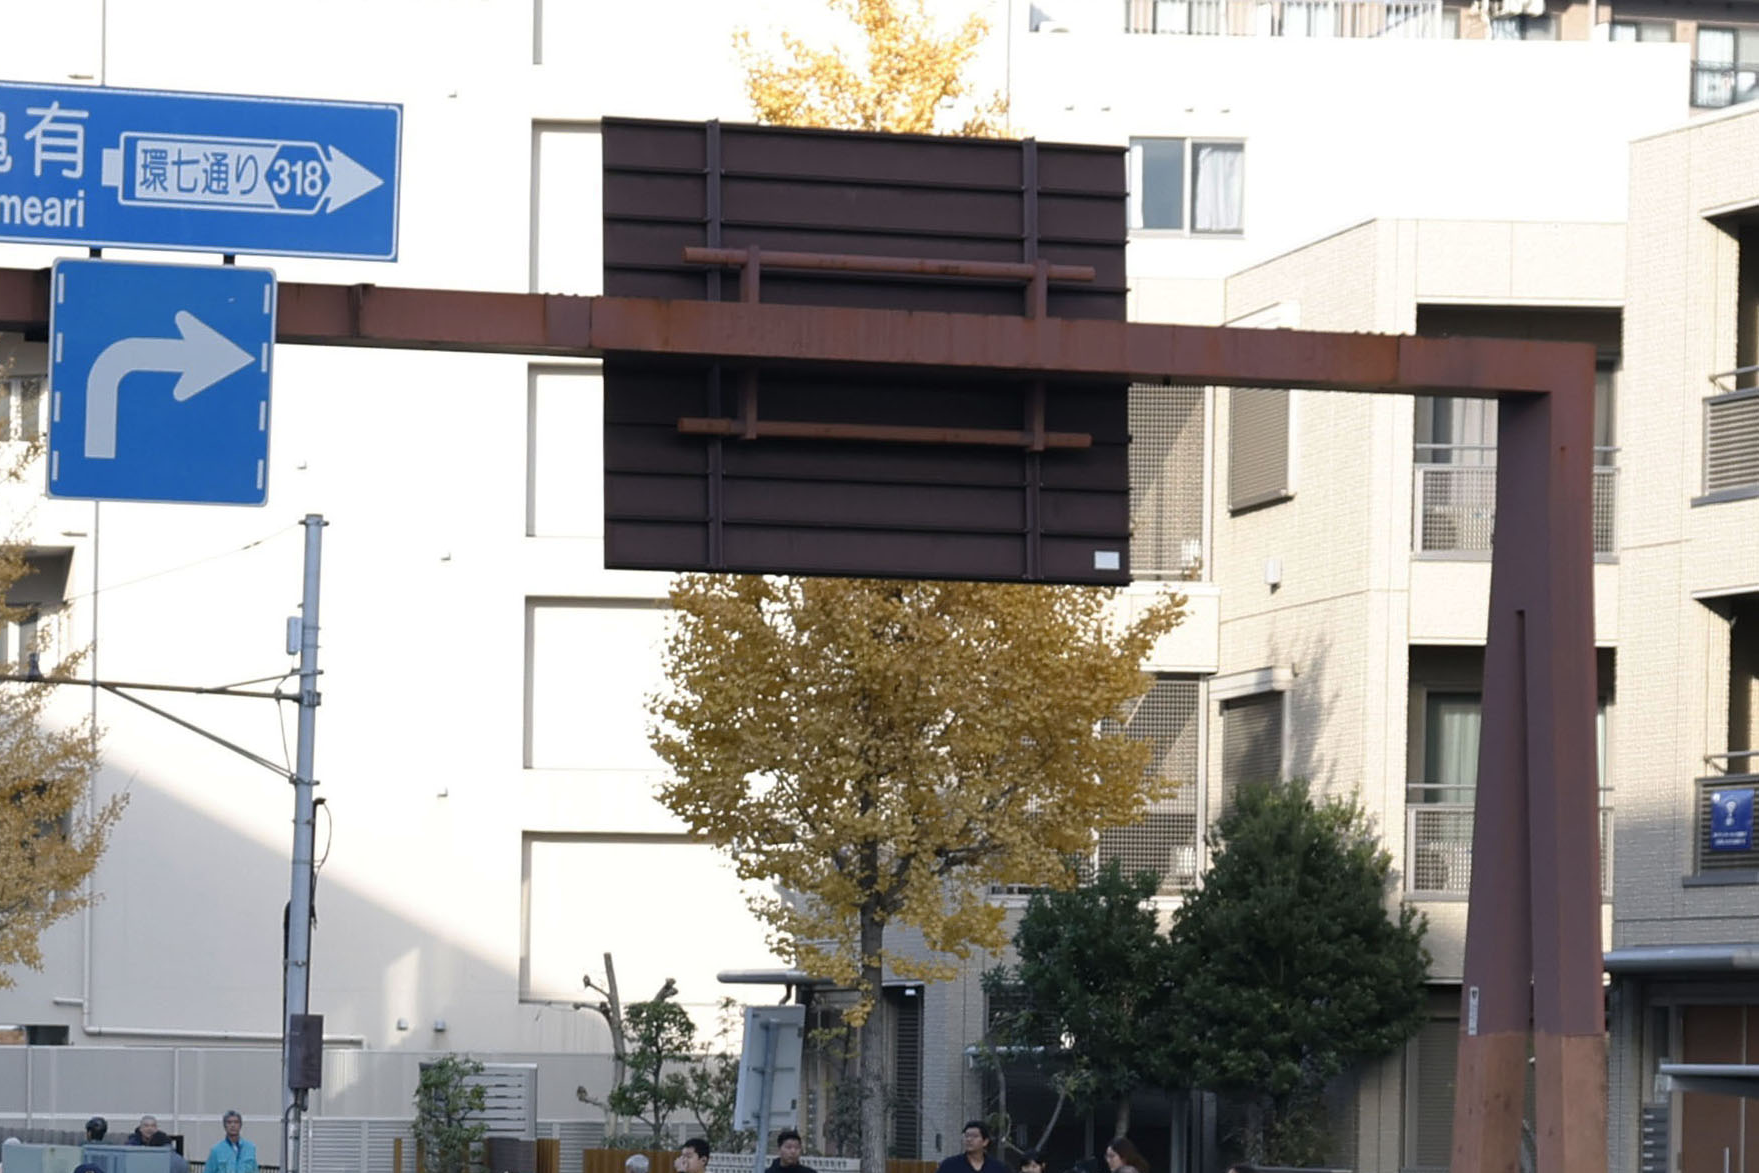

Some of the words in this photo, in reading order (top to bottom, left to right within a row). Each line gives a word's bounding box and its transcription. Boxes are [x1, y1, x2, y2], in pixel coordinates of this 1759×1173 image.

[139, 148, 260, 197] 環七通り
[272, 158, 324, 198] 318
